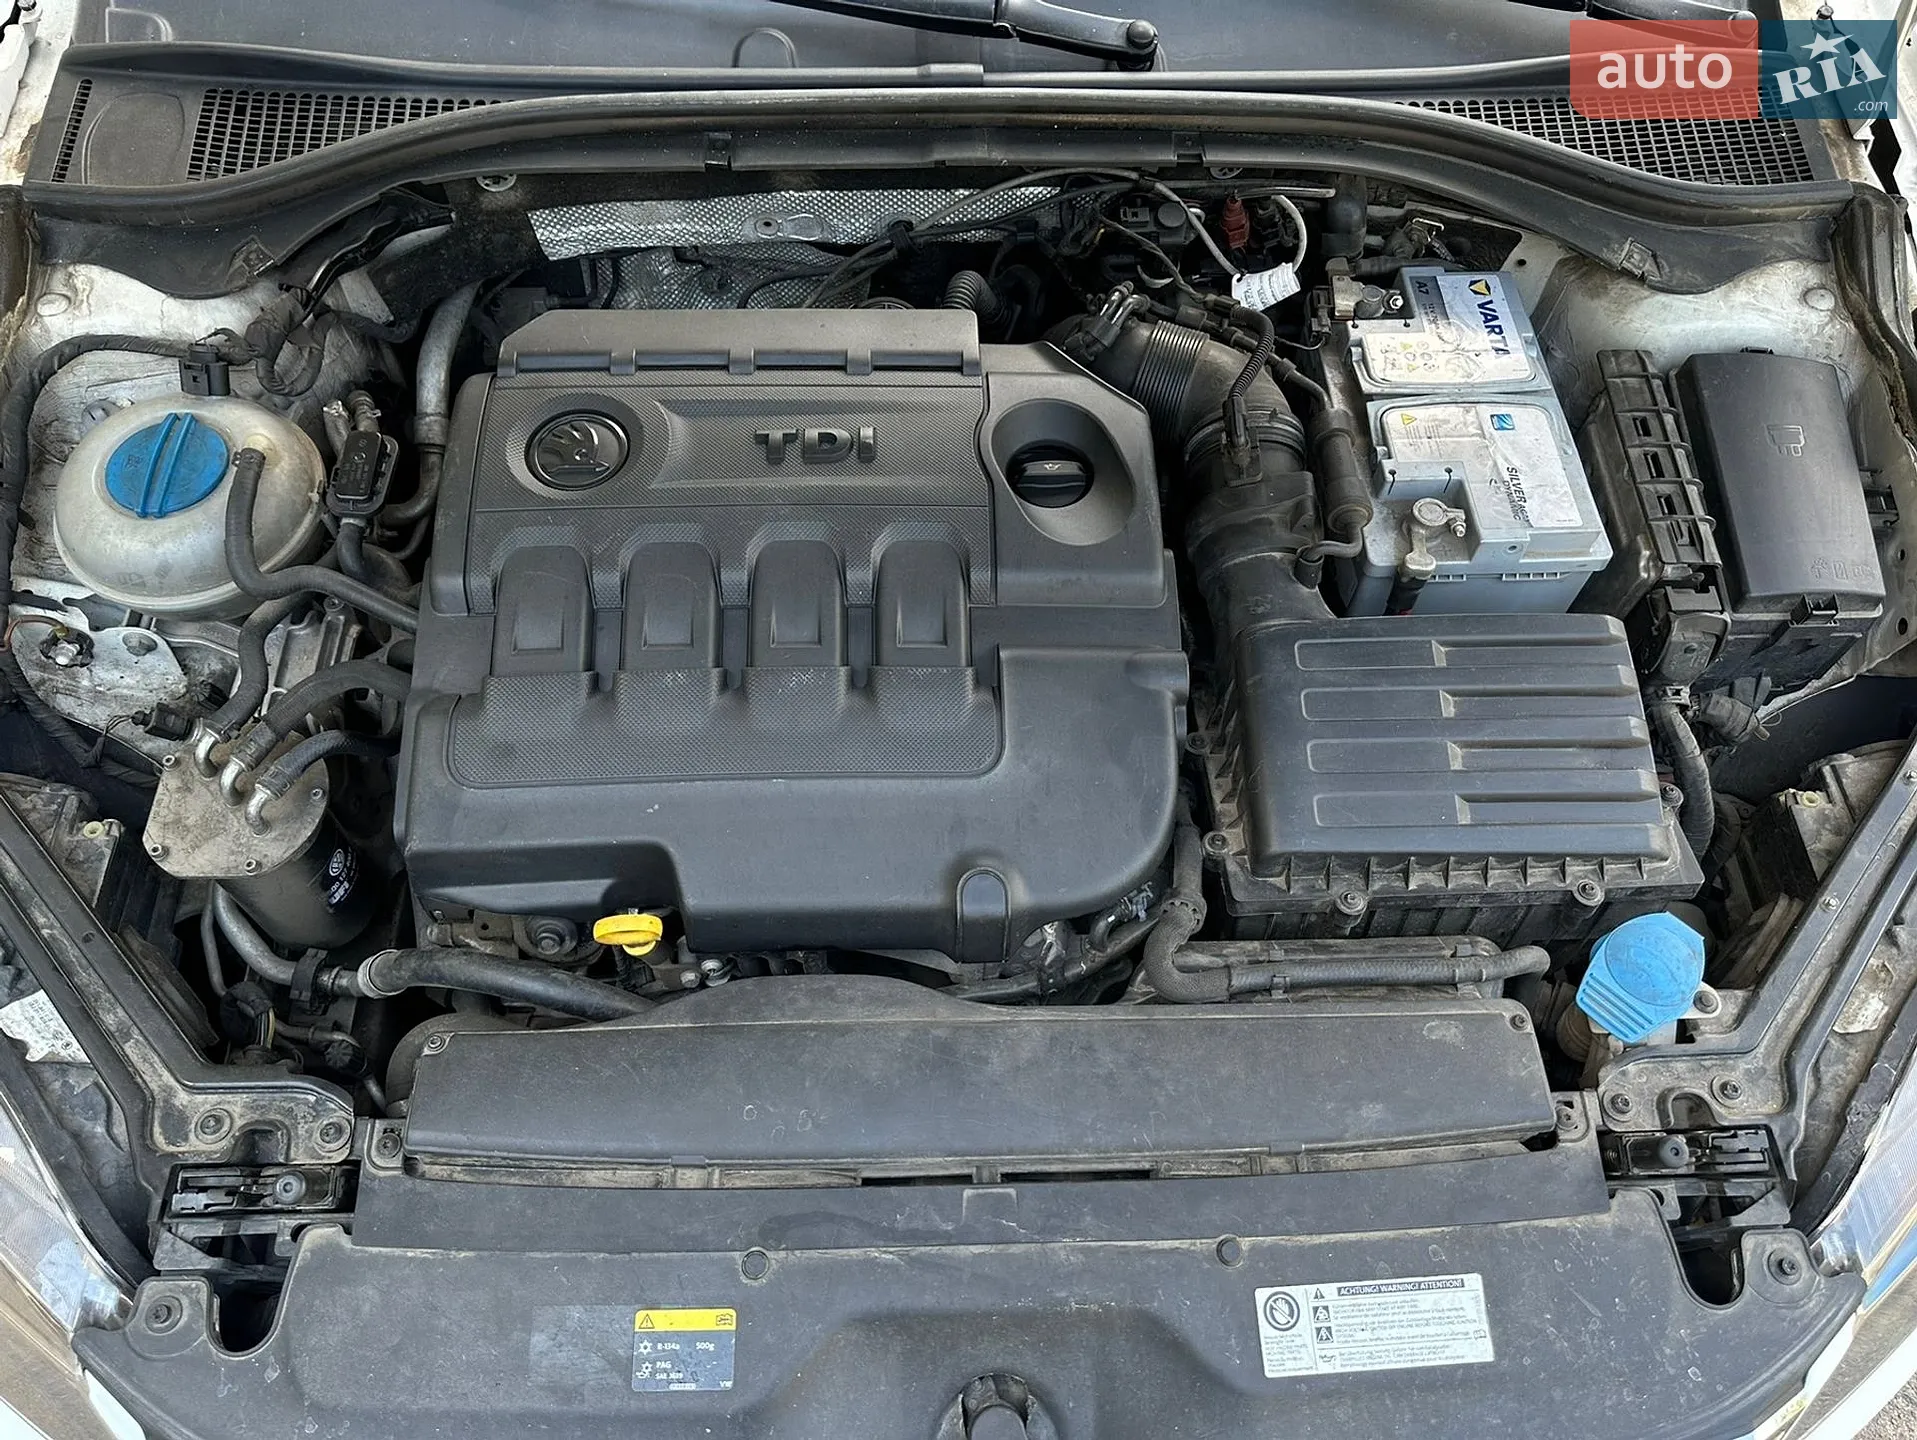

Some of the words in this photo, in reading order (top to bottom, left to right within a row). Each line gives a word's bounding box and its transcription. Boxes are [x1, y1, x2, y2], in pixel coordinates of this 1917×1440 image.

[1416, 280, 1430, 295] A7
[1477, 299, 1511, 356] VARTA
[754, 427, 878, 465] TDI
[1506, 466, 1527, 503] SILVER
[1502, 480, 1521, 521] DYNAMIC
[1340, 1285, 1379, 1295] ACHTUNG!
[1380, 1282, 1419, 1292] WARNING!
[1420, 1279, 1462, 1290] ATTENTION!
[695, 1341, 715, 1351] 500g
[656, 1361, 672, 1369] PAG
